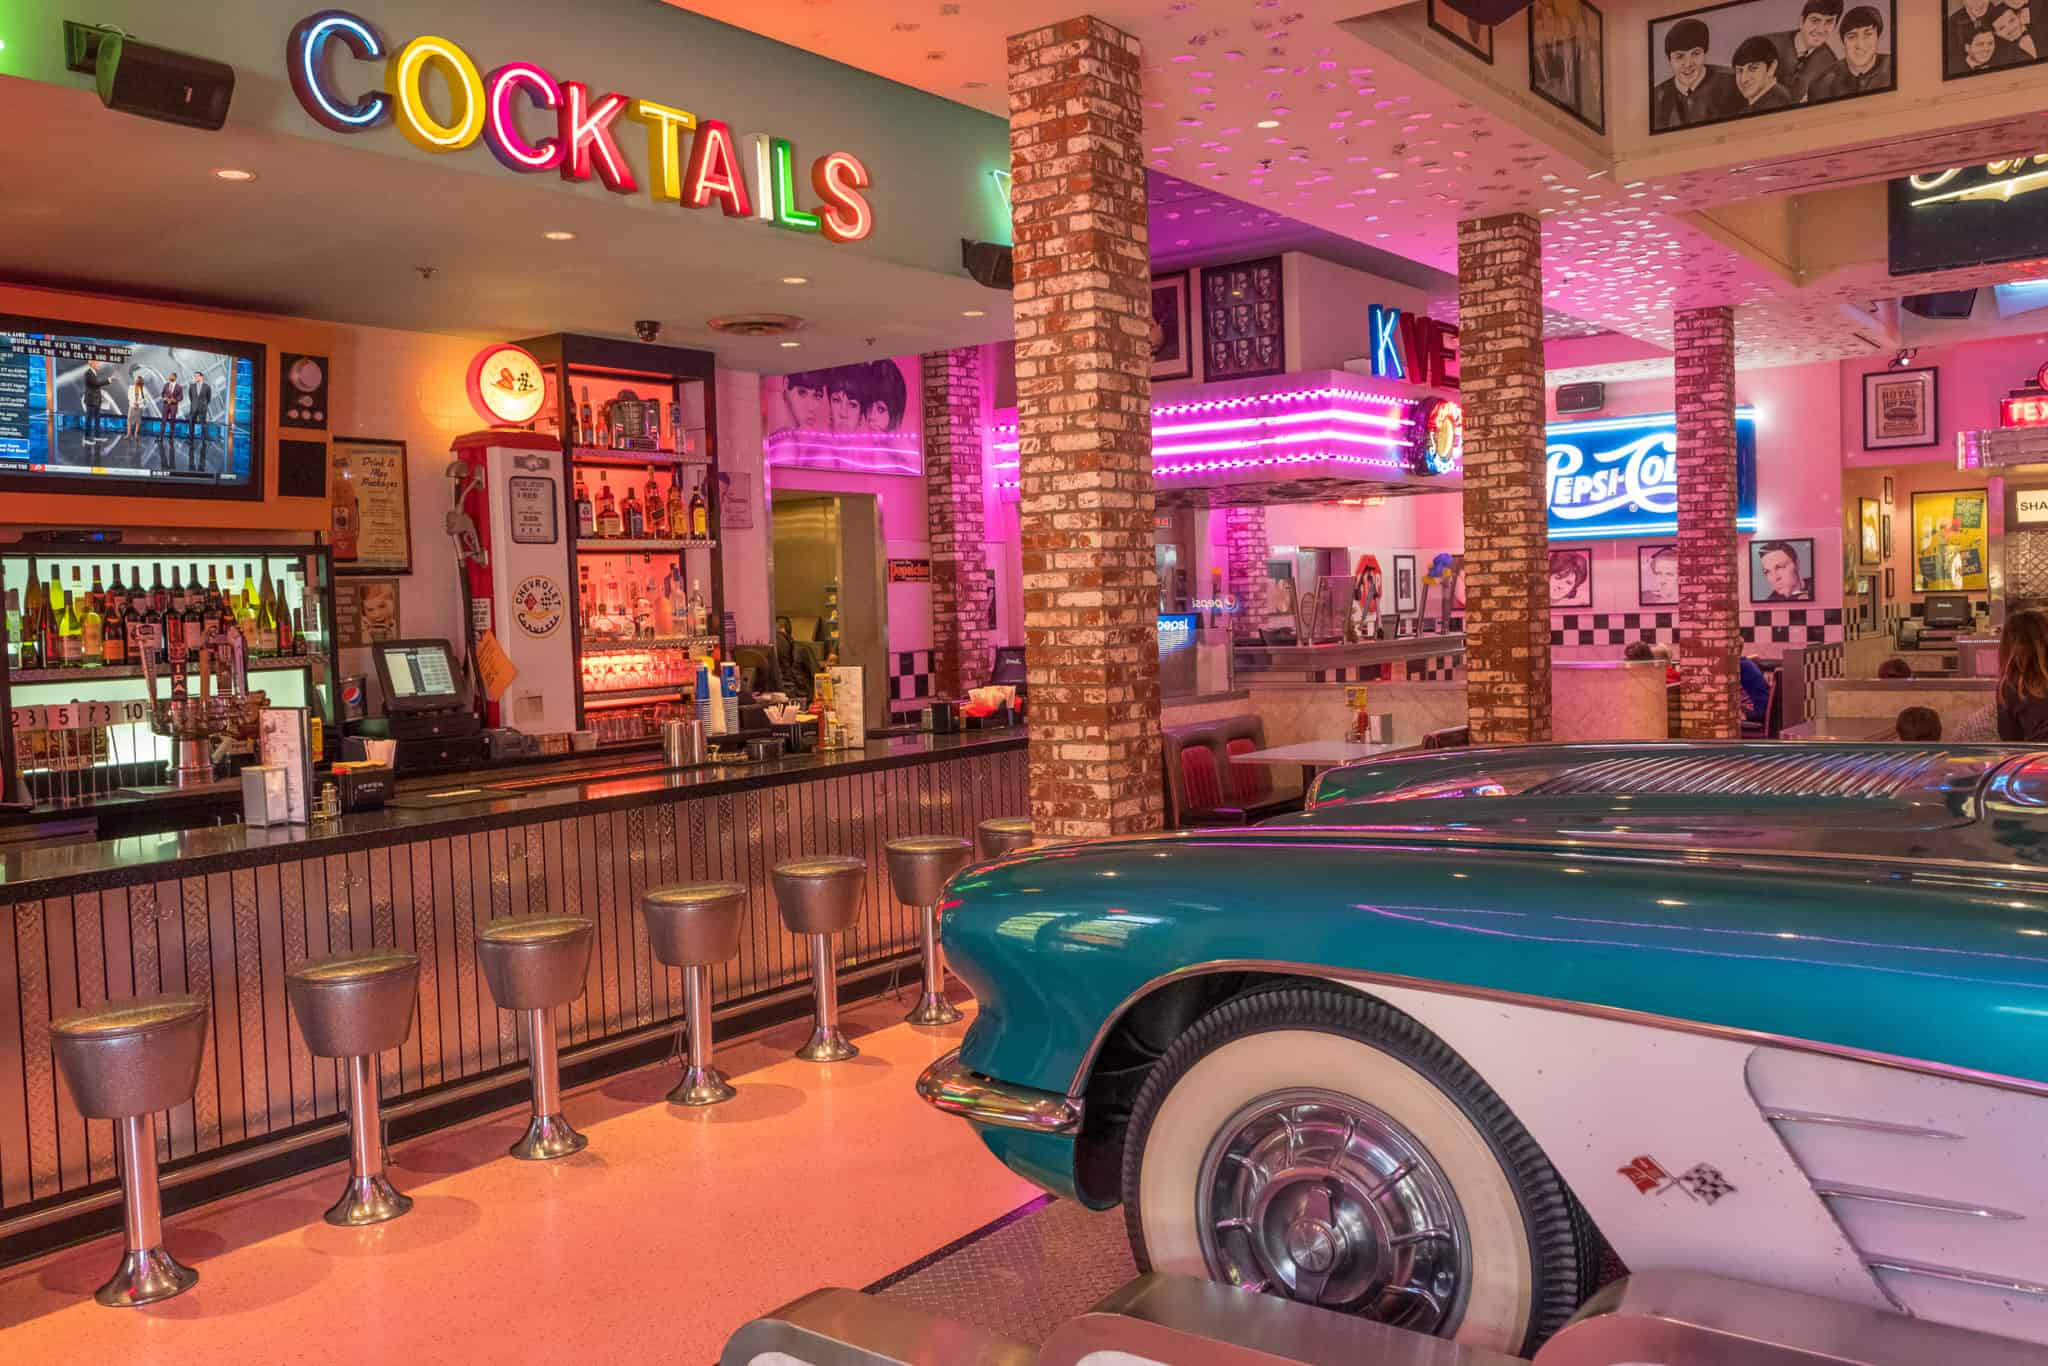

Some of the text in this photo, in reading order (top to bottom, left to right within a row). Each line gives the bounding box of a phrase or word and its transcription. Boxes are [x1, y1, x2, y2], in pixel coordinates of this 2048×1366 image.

[287, 9, 871, 243] COCKTAILS
[515, 579, 561, 605] CHEVROLET
[174, 663, 185, 693] IPA
[58, 708, 69, 725] 5
[122, 703, 143, 720] 10
